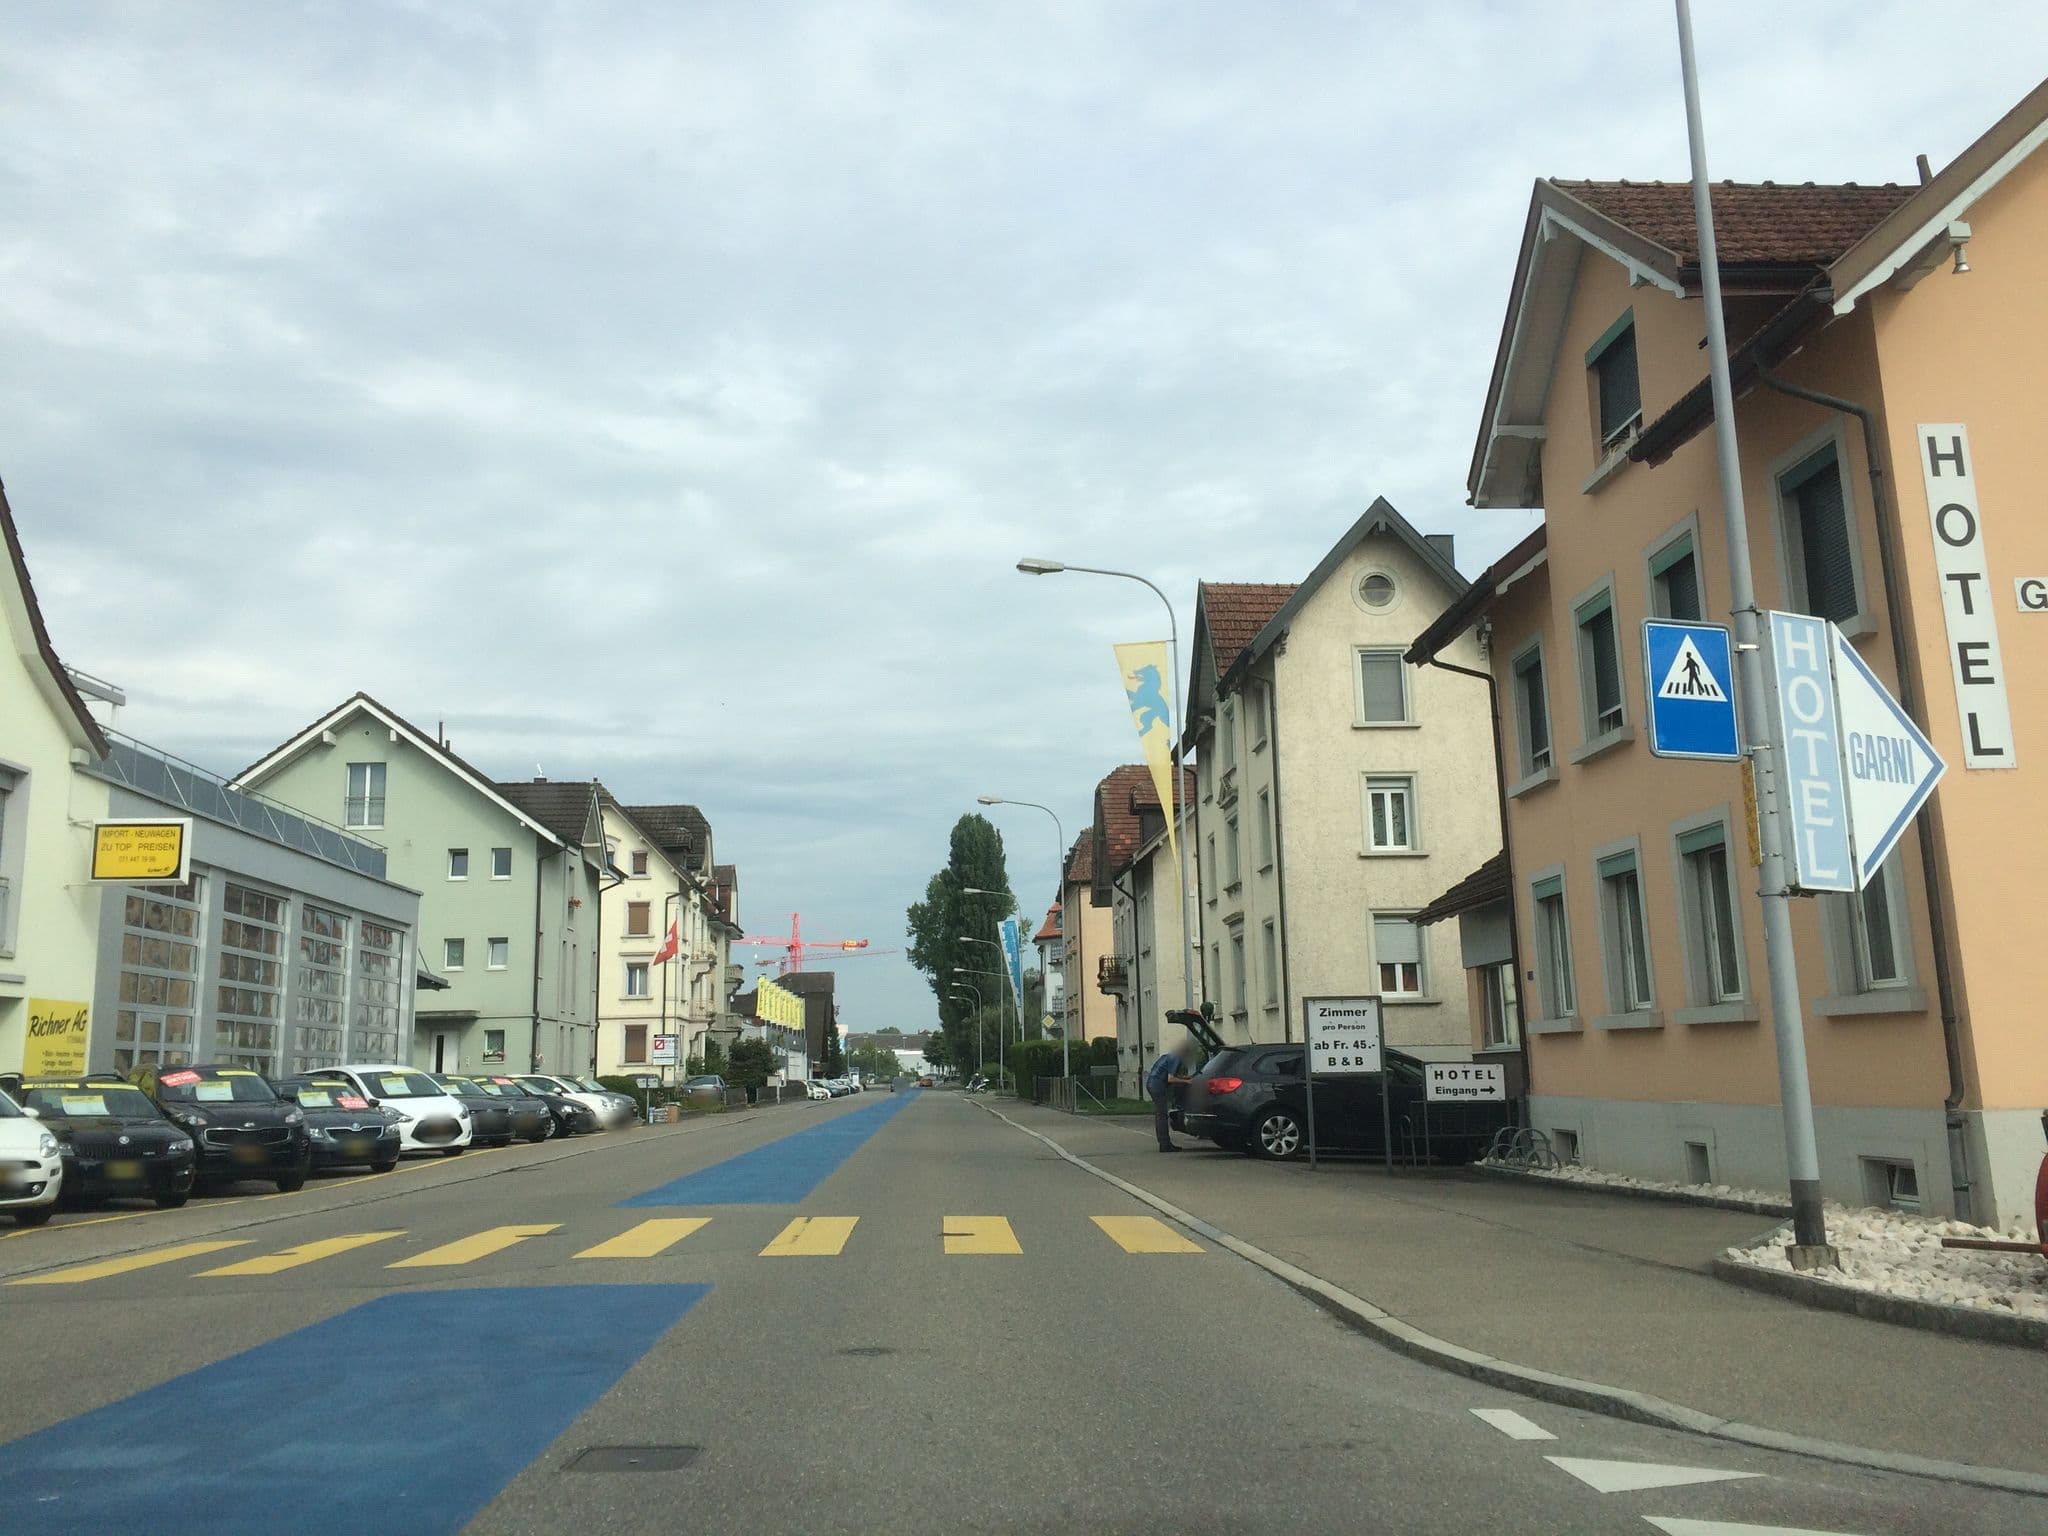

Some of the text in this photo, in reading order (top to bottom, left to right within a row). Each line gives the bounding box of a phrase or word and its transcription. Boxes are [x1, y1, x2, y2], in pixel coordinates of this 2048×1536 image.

[1927, 436, 2004, 756] HOTEL
[2021, 579, 2048, 609] G
[1783, 621, 1839, 880] HOTEL
[1849, 731, 1916, 785] GARNI
[101, 830, 129, 838] IMPORT
[135, 830, 176, 838] NEUWAGEN
[101, 843, 175, 851] ZU TOP PREISEN
[1319, 1008, 1367, 1017] Zimmer
[28, 1009, 88, 1037] Richner AG
[1314, 1041, 1329, 1050] ab
[1334, 1040, 1348, 1049] Fr.
[1328, 1057, 1363, 1066] B & B
[1434, 1070, 1496, 1080] HOTEL
[1435, 1086, 1477, 1096] Eingang
